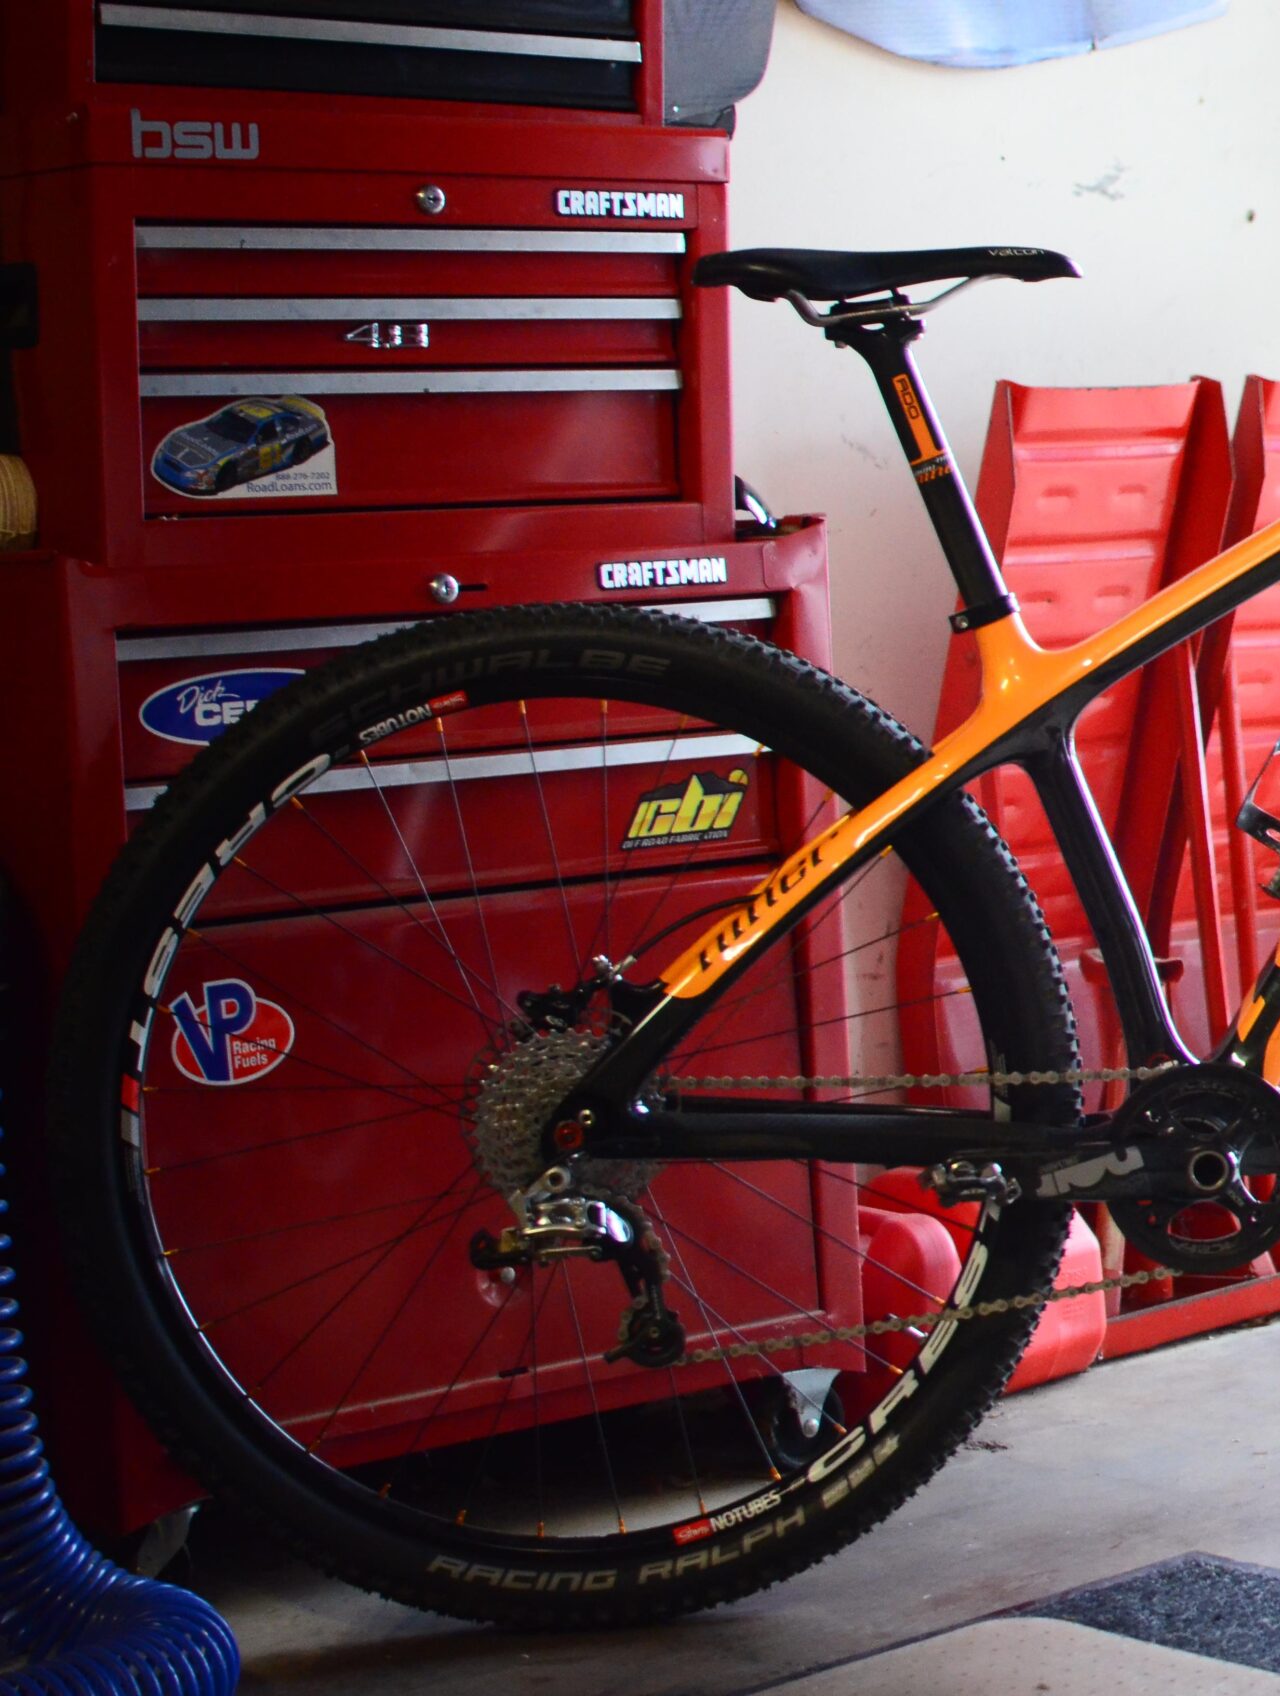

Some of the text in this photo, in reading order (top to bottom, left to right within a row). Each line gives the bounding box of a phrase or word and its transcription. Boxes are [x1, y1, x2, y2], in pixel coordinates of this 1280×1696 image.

[131, 107, 259, 159] bsw
[557, 190, 684, 218] CRAFTSMAN
[247, 481, 333, 492] RoadLoans.com
[600, 557, 727, 589] CRAFTSMAN
[358, 702, 433, 744] NOTUBES
[168, 978, 257, 1084] VP
[232, 1037, 277, 1055] Racing
[233, 1052, 268, 1069] Fuels
[710, 1489, 782, 1533] NOTUBES
[426, 1508, 807, 1592] RACING RALPH
